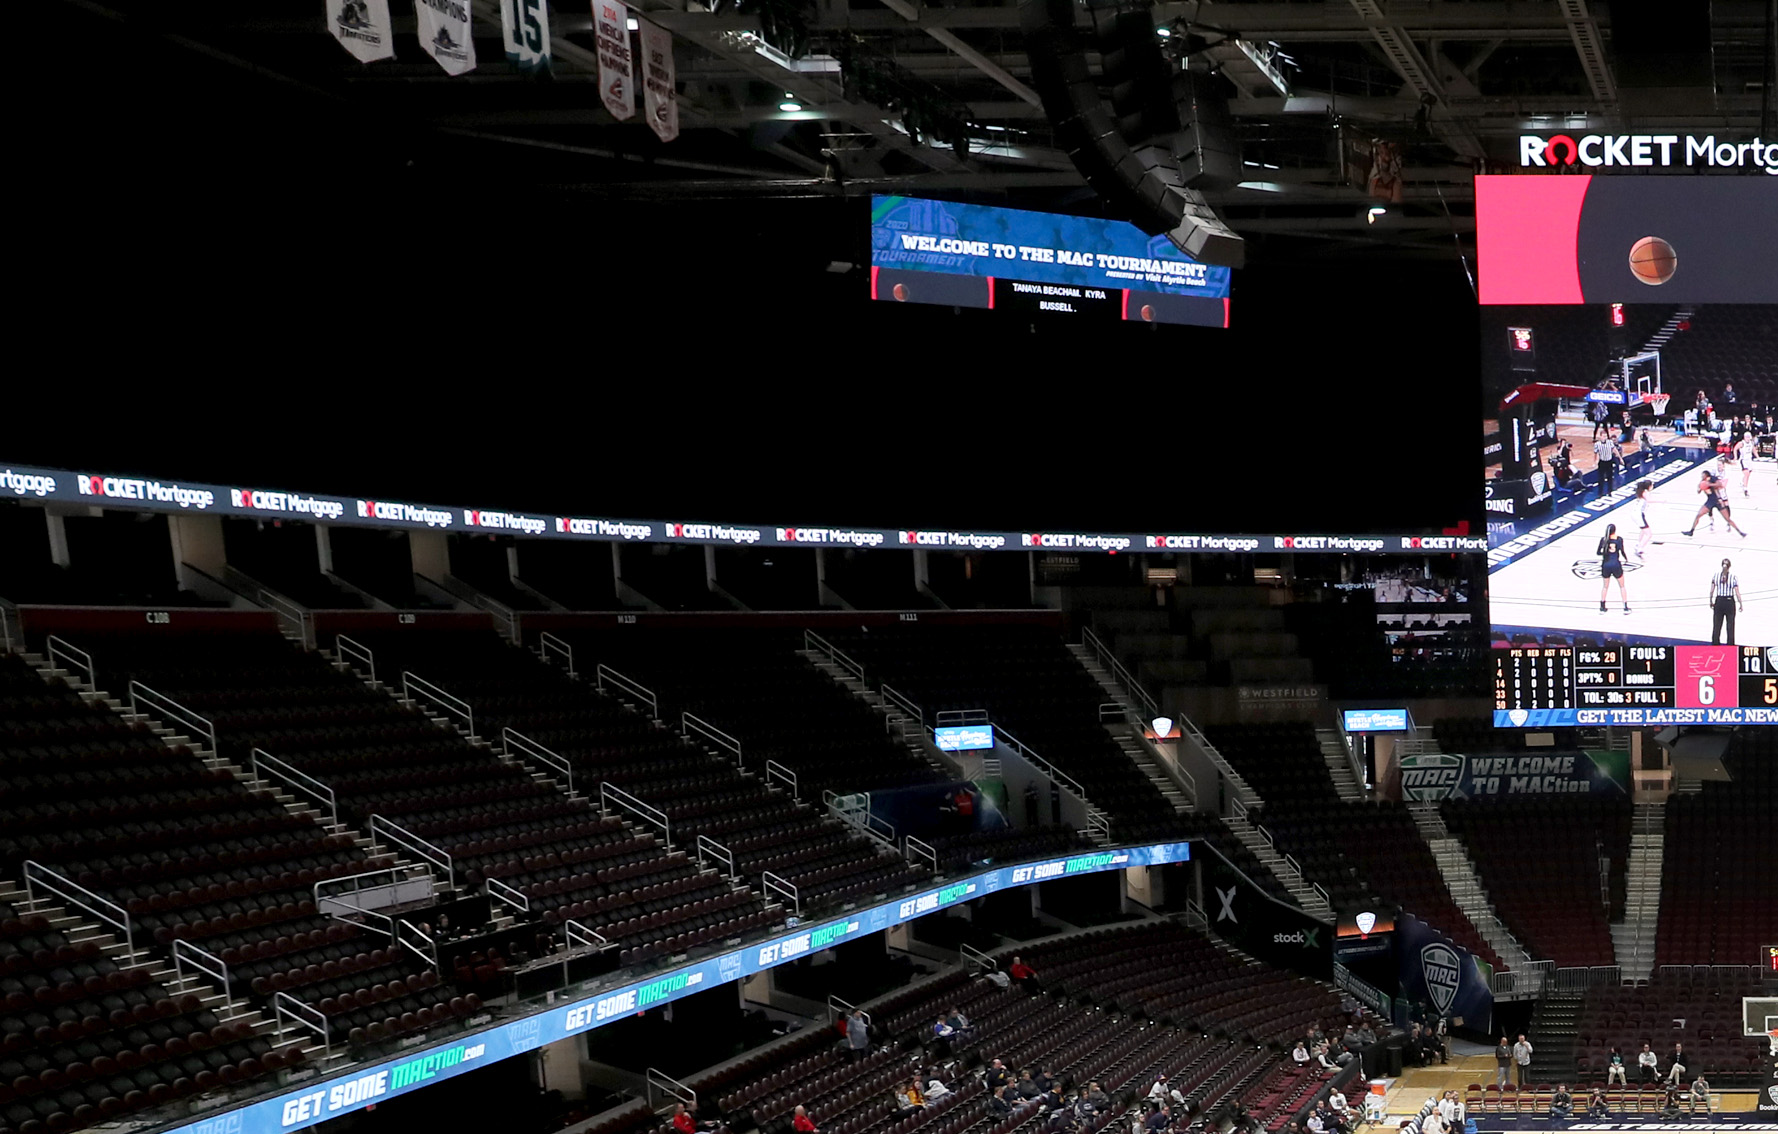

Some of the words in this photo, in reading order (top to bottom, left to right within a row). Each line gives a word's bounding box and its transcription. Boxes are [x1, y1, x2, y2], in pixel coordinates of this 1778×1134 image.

[512, 0, 544, 54] 15
[1520, 135, 1677, 166] ROCKET
[902, 234, 989, 258] WELCOME
[993, 243, 1016, 260] TO
[1019, 246, 1054, 264] THE
[1057, 249, 1093, 268] MAC
[1097, 254, 1207, 278] TOURNAMENT
[1145, 272, 1161, 282] Visit
[1162, 274, 1184, 286] Myrtle
[1012, 283, 1042, 295] TANAYA
[1085, 289, 1106, 300] KYRA
[1590, 392, 1622, 402] GEICO
[78, 474, 145, 500] ROCKET
[147, 481, 213, 508] Mortgage
[231, 489, 287, 512] ROCKET
[288, 494, 343, 518] Mortgage
[357, 500, 404, 520] ROCKET
[405, 504, 452, 527] Mortgage
[666, 523, 711, 539] ROCKET
[712, 526, 760, 543] Mortgage
[776, 528, 828, 543] ROCKET
[830, 529, 883, 546] Mortgage
[1146, 535, 1199, 549] ROCKET
[1201, 536, 1258, 551] Mortgage
[1275, 536, 1326, 549] ROCKET
[1328, 537, 1384, 551] Mortgage
[1580, 652, 1600, 663] FG%
[1604, 652, 1616, 663] 29
[1630, 648, 1666, 660] FOULS
[1744, 647, 1759, 657] QTR
[1743, 658, 1761, 673] 1Q
[1578, 673, 1603, 684] 3PT%
[1608, 672, 1615, 684] 0
[1626, 674, 1654, 685] BONUS
[1584, 692, 1604, 704] TOL:
[1607, 692, 1624, 703] 30s
[1635, 692, 1658, 703] FULL
[1698, 675, 1715, 705] 6
[1577, 710, 1608, 723] GET
[1611, 710, 1643, 723] THE
[1645, 709, 1704, 723] LATEST
[1708, 709, 1745, 723] MAC
[1471, 756, 1575, 775] WELCOME
[1401, 769, 1458, 786] MAC
[1472, 778, 1499, 795] TO
[1509, 777, 1591, 794] MACtion
[1012, 868, 1034, 883] GET
[1035, 861, 1065, 879] SOME
[1424, 964, 1458, 987] MAC
[566, 1004, 595, 1031] GET
[596, 990, 636, 1021] SOME
[282, 1090, 327, 1127] GET
[329, 1070, 388, 1111] SOME
